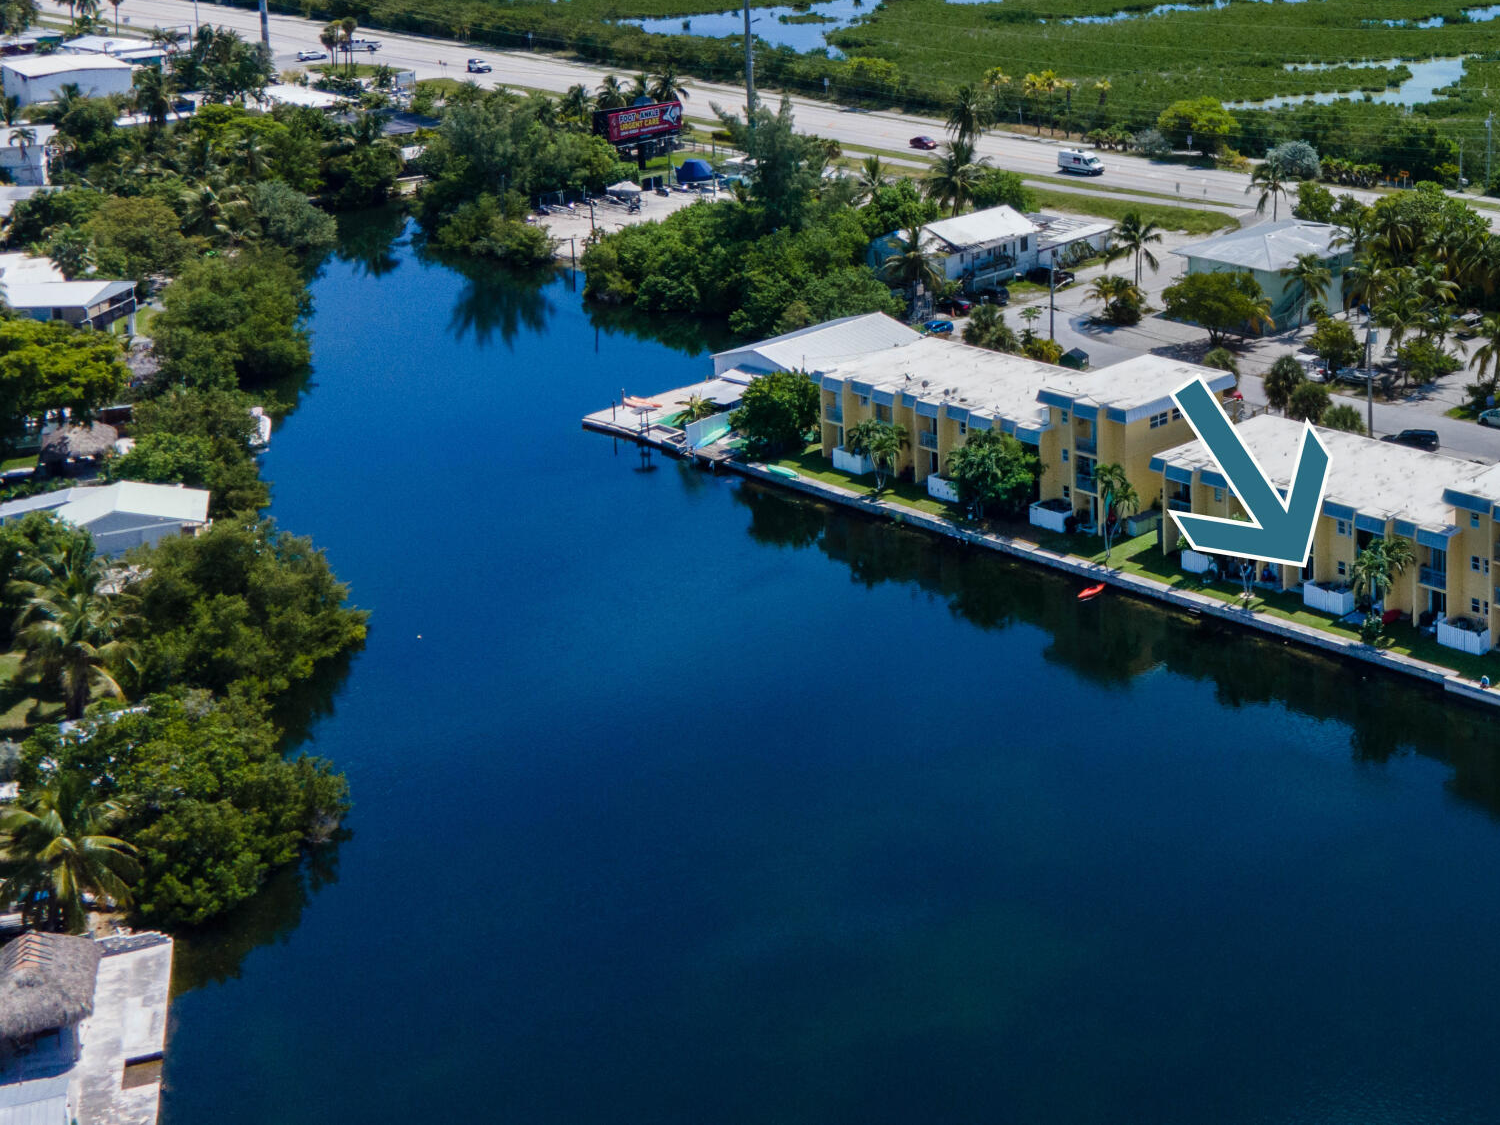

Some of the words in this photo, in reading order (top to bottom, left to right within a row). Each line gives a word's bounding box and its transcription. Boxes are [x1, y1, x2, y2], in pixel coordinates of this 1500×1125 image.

[619, 113, 636, 123] FOOT
[640, 109, 659, 119] ANKLE
[620, 121, 643, 130] URGENT
[645, 118, 659, 126] CARE
